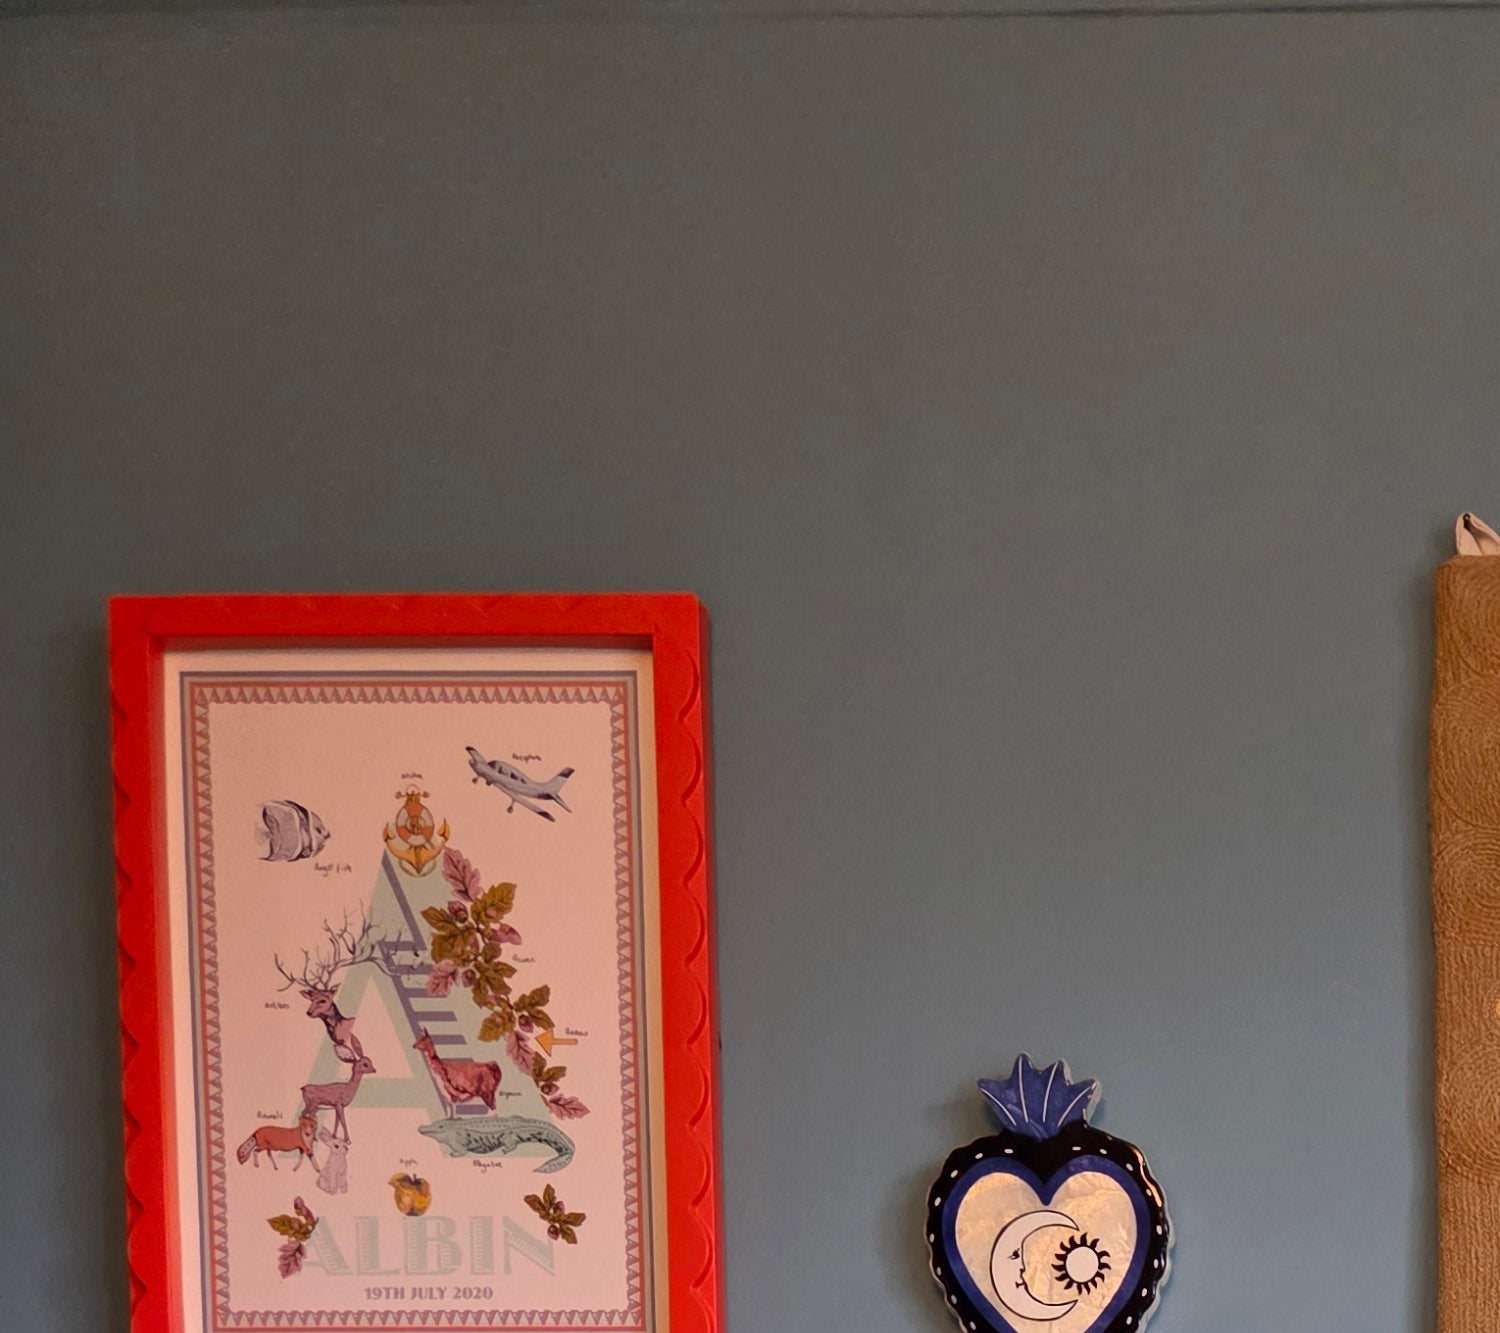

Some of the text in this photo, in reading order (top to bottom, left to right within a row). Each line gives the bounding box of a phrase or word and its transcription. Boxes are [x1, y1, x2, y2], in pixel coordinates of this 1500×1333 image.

[296, 1215, 556, 1277] ALBIN
[364, 1286, 493, 1300] 19TH JULY 2020
